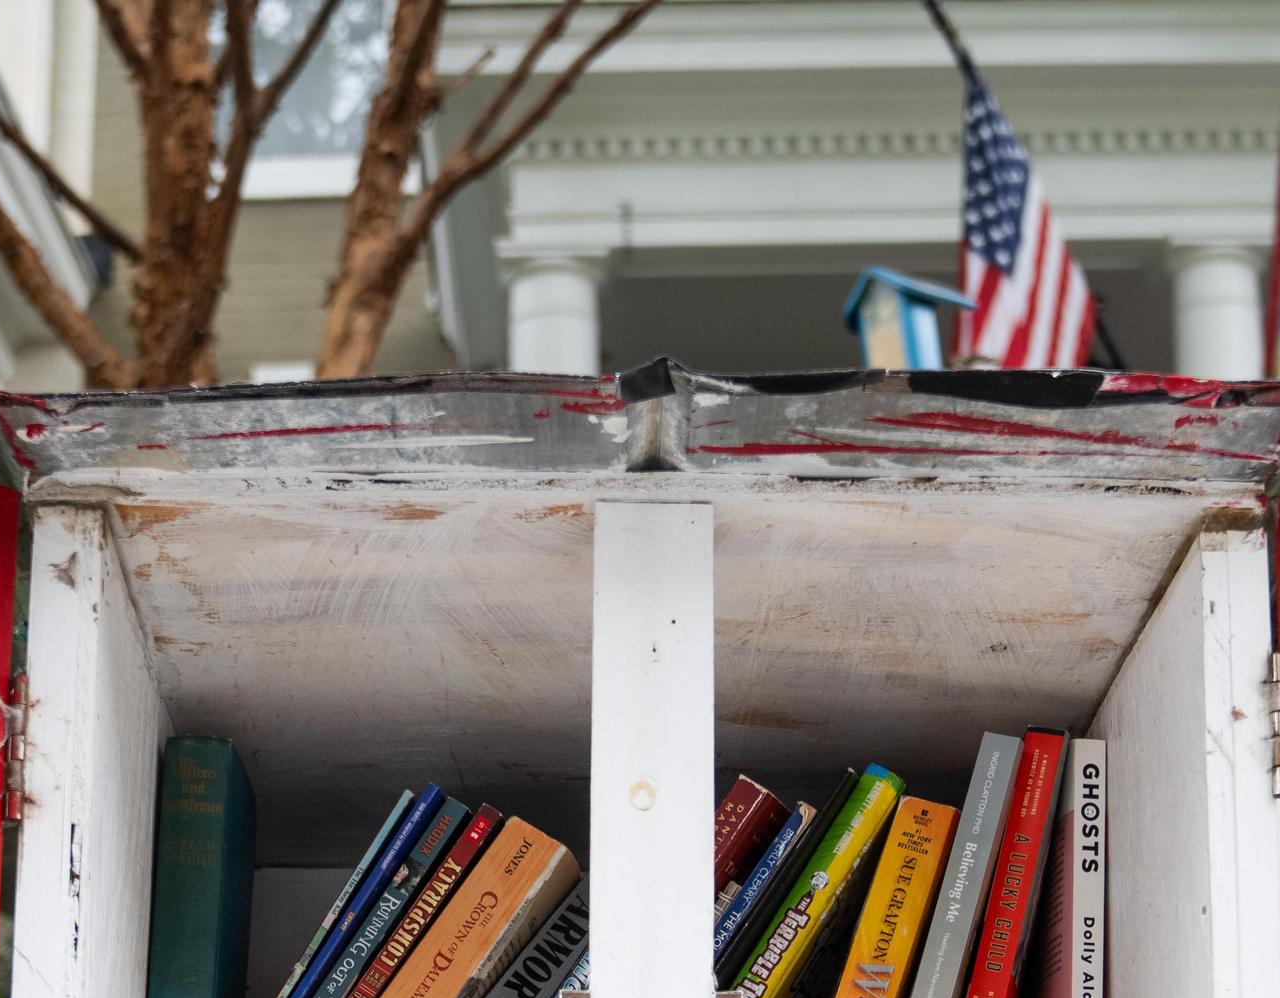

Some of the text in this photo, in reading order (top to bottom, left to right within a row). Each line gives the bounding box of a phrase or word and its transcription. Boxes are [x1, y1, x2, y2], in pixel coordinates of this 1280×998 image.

[972, 751, 1000, 835] INGRID CLAYTON PHD
[420, 815, 453, 857] HADDIX
[901, 831, 933, 843] NEW YORK
[1080, 763, 1100, 874] GHOSTS
[505, 837, 533, 876] JONES
[743, 828, 794, 906] BEVERLY CLEARY
[897, 842, 928, 855] BESTSELLER
[907, 839, 924, 848] TIMES
[797, 897, 811, 912] THE
[946, 842, 978, 923] Believing Me
[986, 833, 1031, 973] A LUCKY CHILD
[353, 892, 402, 958] RUNNING
[380, 857, 463, 967] CONSPIRACY
[454, 891, 499, 941] CROWN
[479, 913, 494, 929] THE
[724, 911, 742, 931] THE
[872, 855, 918, 963] SUE GRAFTON
[448, 942, 458, 954] OF
[750, 908, 810, 980] TERRIBLE
[1081, 917, 1095, 965] Dolly
[334, 958, 355, 986] OUT
